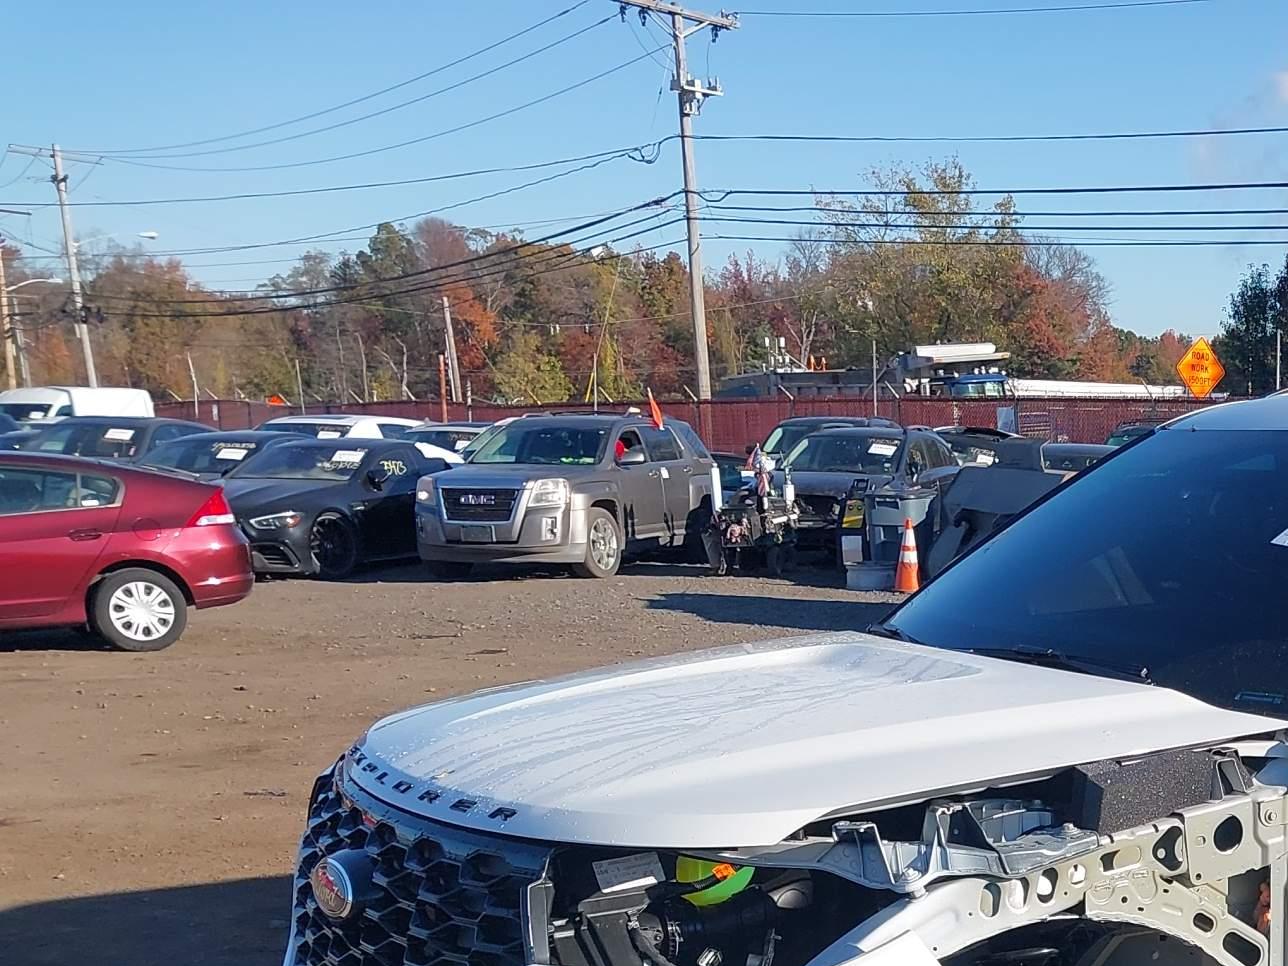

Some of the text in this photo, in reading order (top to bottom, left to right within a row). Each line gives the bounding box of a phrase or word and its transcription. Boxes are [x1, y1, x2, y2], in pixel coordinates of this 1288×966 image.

[1191, 351, 1210, 362] ROAD
[1191, 363, 1209, 373] WORK
[459, 494, 495, 505] GMC
[349, 745, 518, 821] EXPLORER
